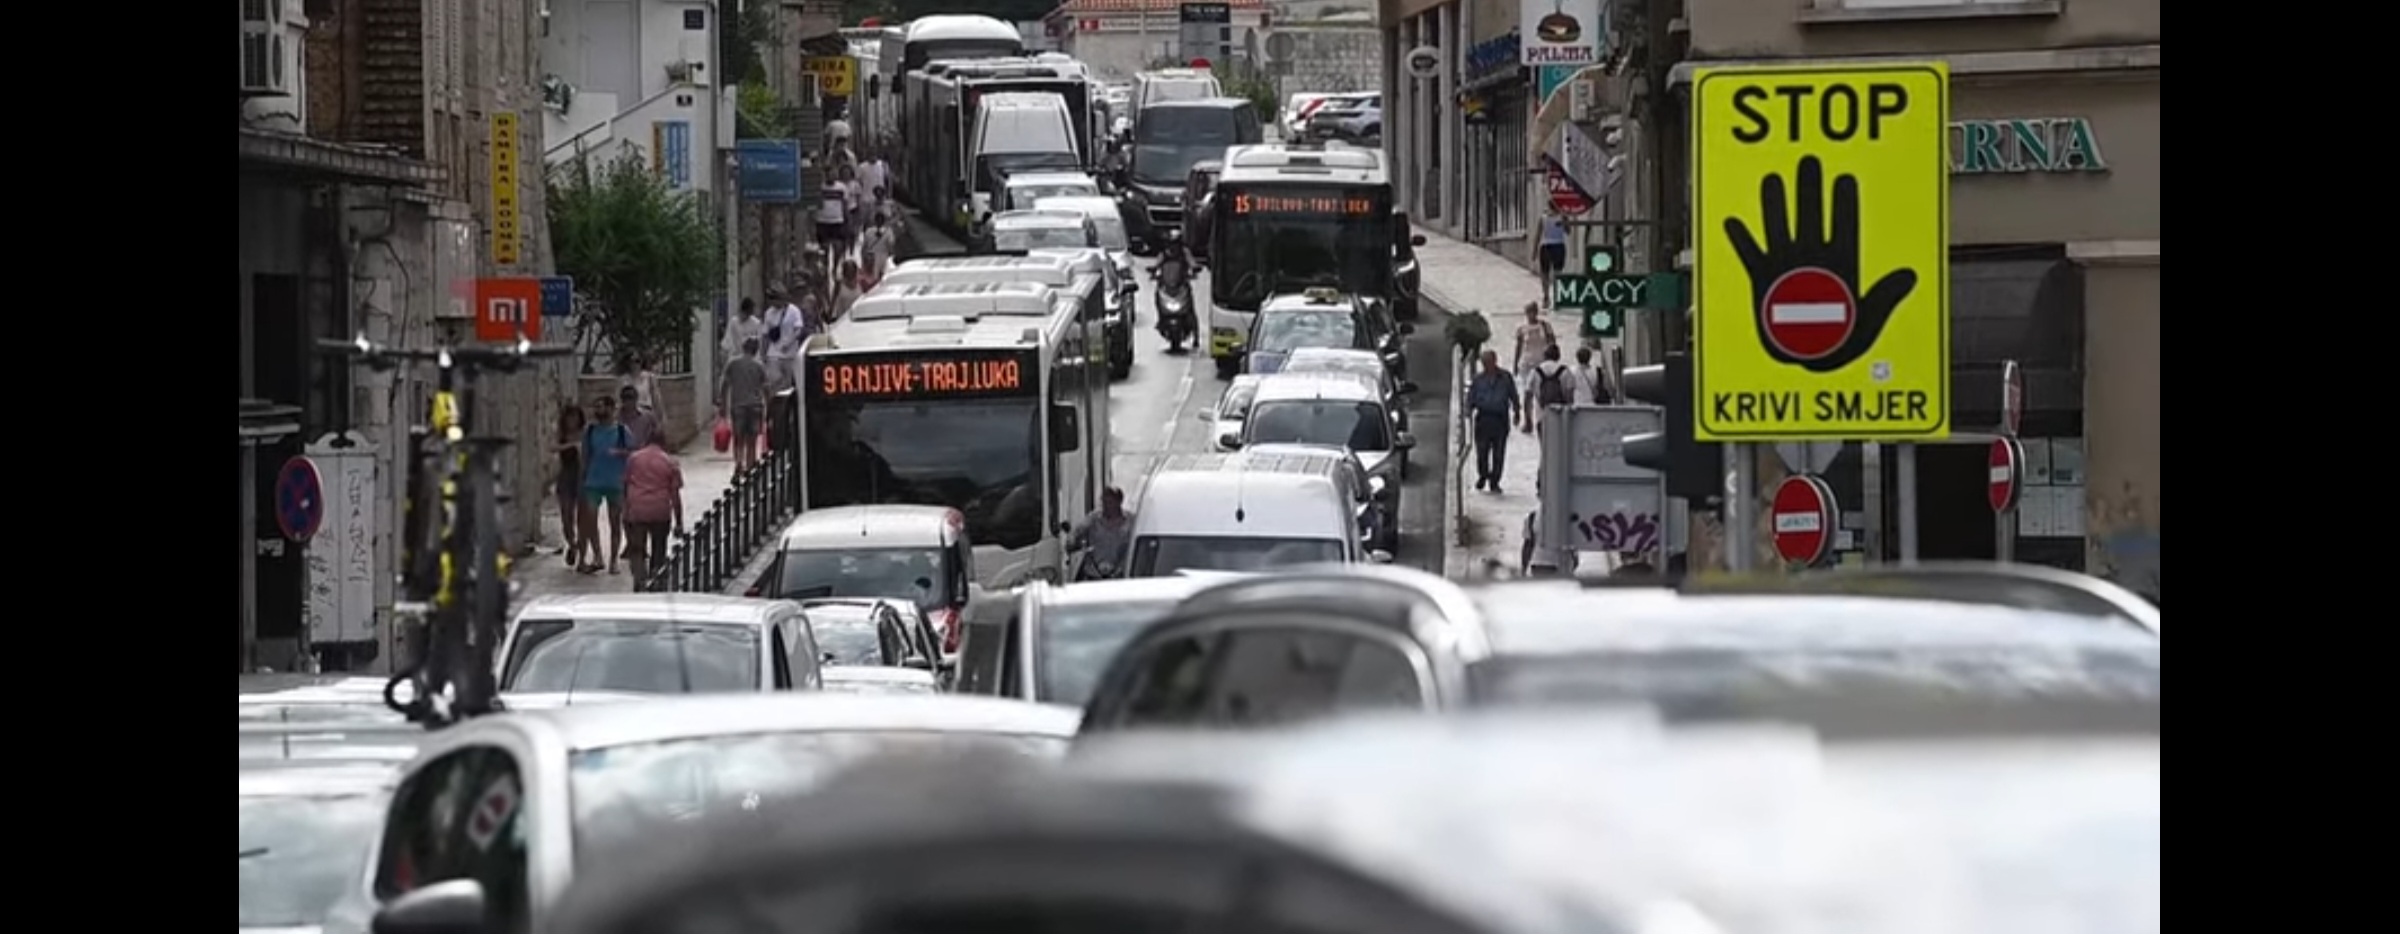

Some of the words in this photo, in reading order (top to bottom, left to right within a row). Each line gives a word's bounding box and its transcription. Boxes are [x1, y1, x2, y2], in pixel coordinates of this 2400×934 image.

[1526, 46, 1593, 61] PALMA
[1731, 83, 1909, 143] STOP
[497, 117, 511, 185] DAMIRA
[1235, 194, 1250, 213] 15
[498, 199, 513, 251] ROOMS
[1556, 279, 1647, 303] MACY
[823, 365, 836, 394] 9
[1713, 391, 1800, 423] KRIVI
[1813, 390, 1928, 422] SMJER
